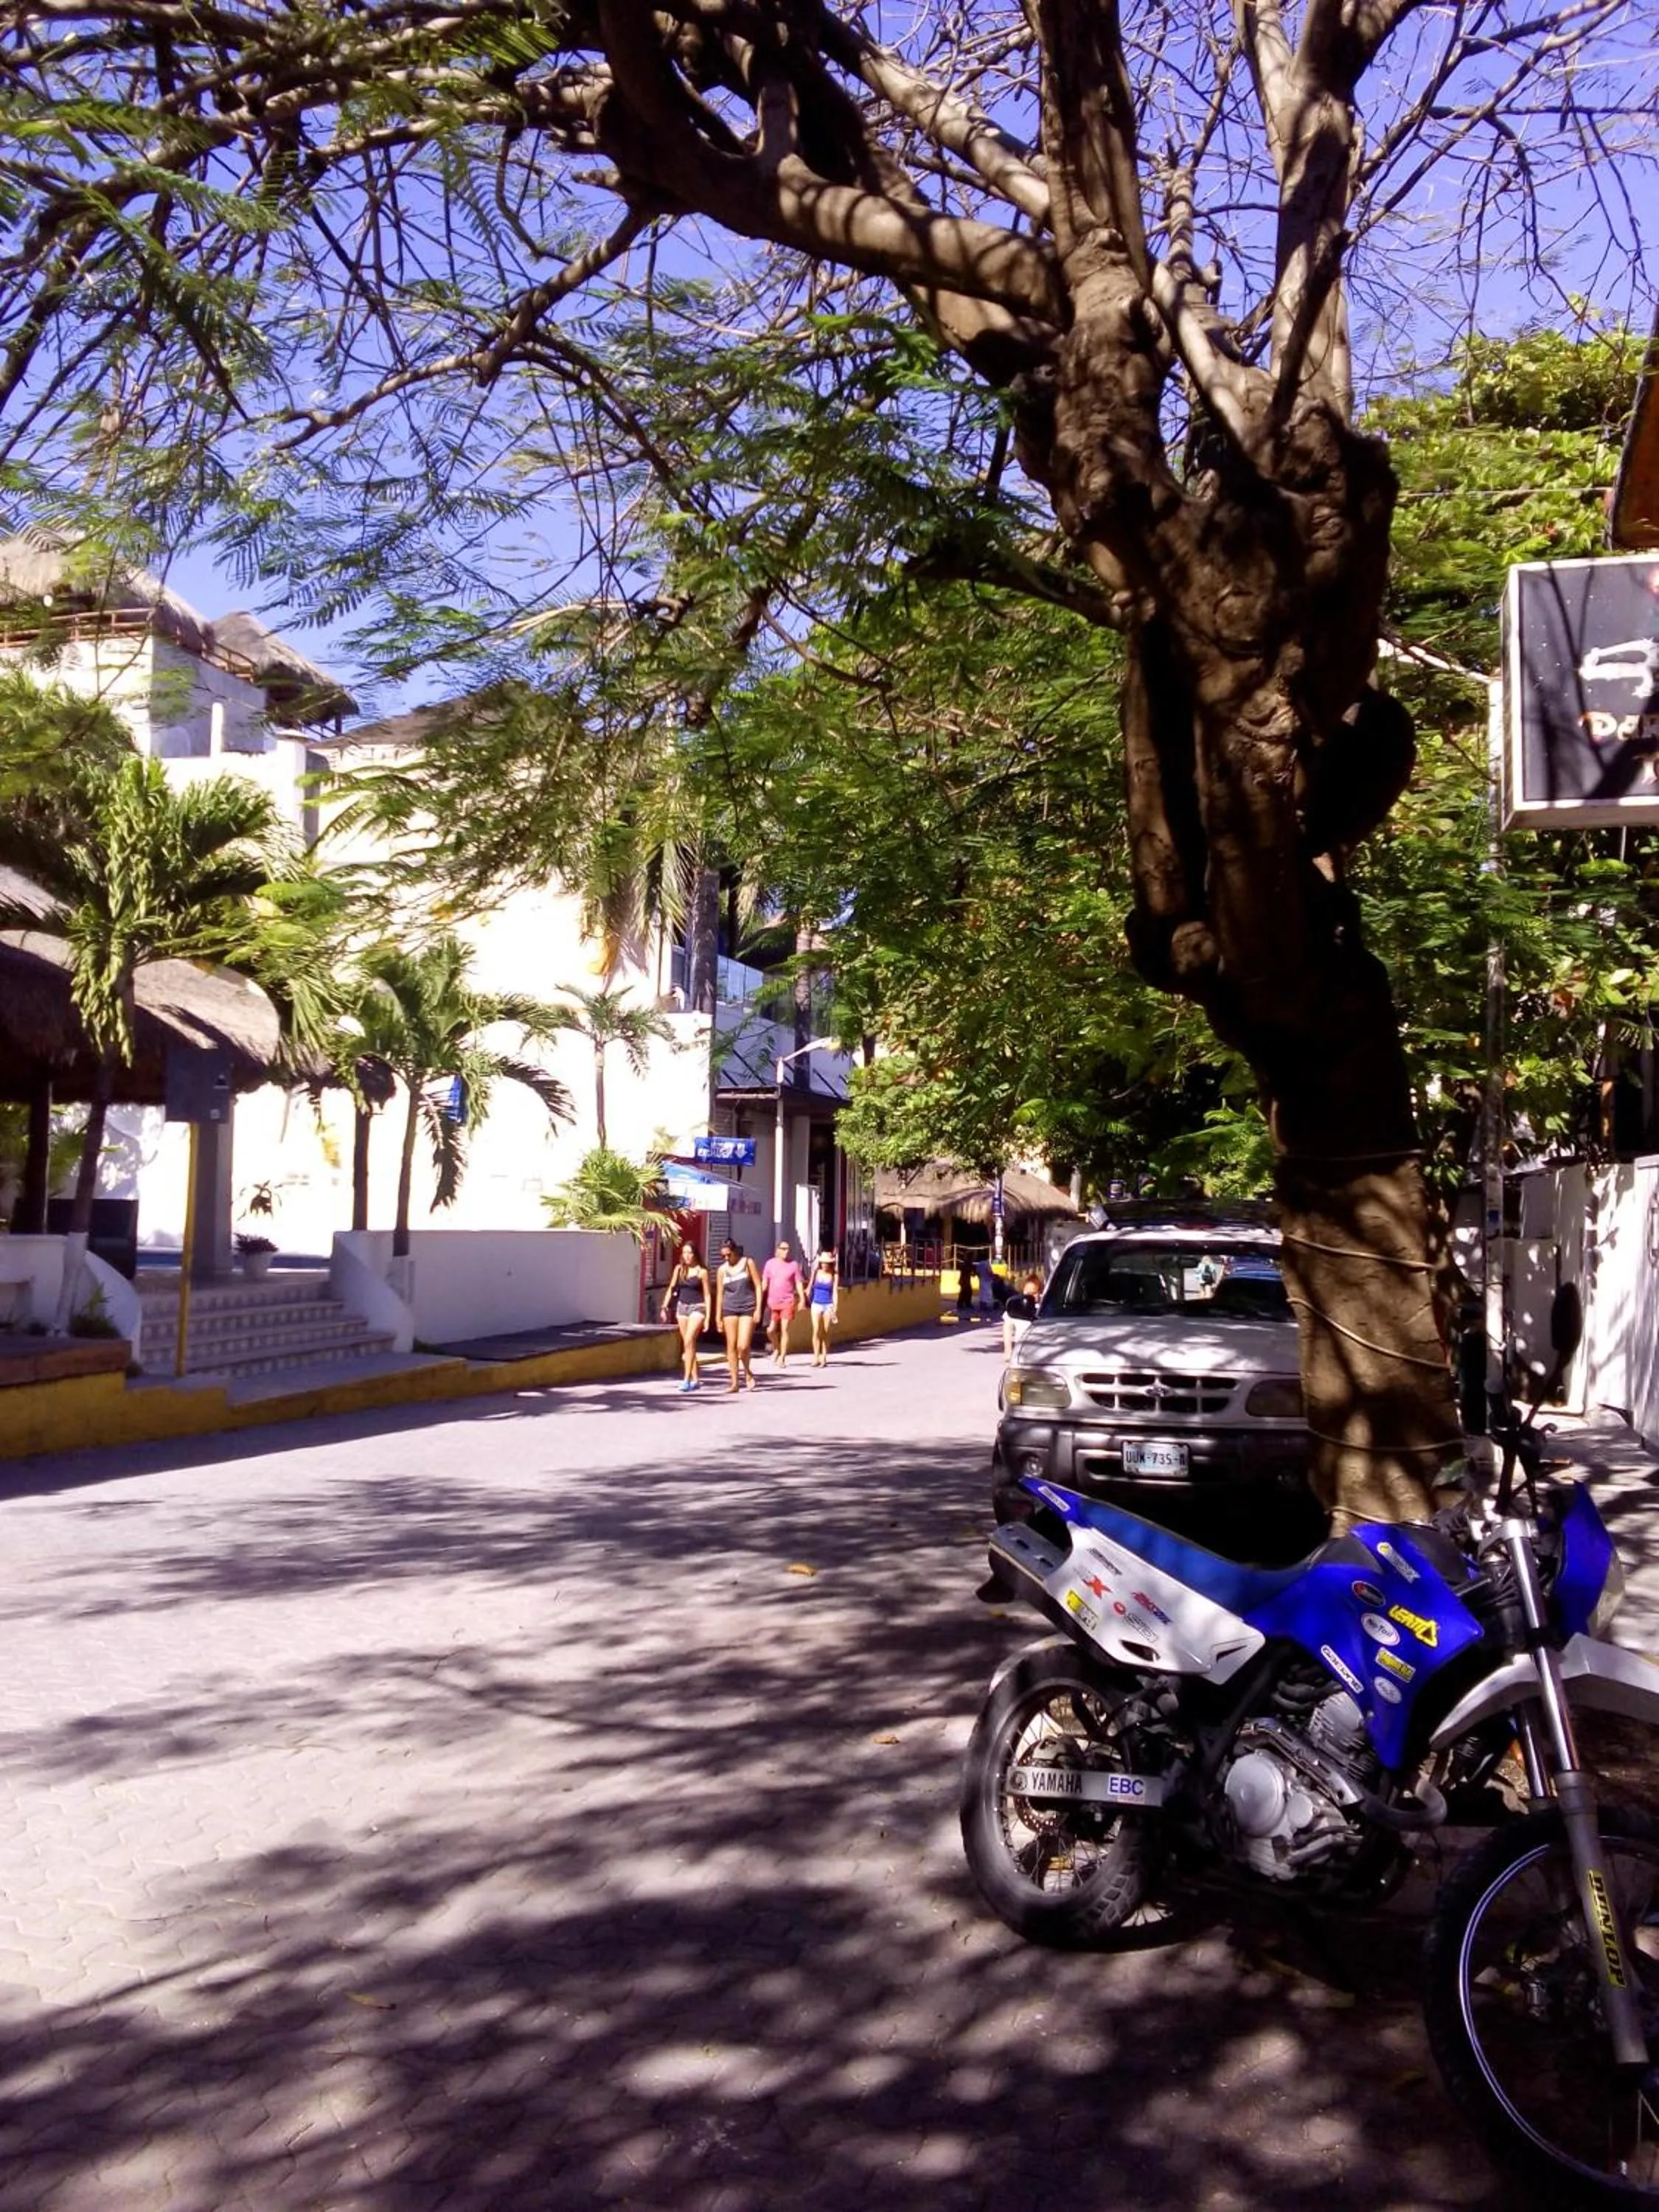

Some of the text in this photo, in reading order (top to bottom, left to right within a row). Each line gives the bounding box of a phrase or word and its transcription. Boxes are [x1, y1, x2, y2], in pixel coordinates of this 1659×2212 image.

[1032, 1771, 1082, 1793] YAMAHA
[1110, 1777, 1144, 1795] EBC
[1588, 1872, 1627, 1986] DUNLOP
